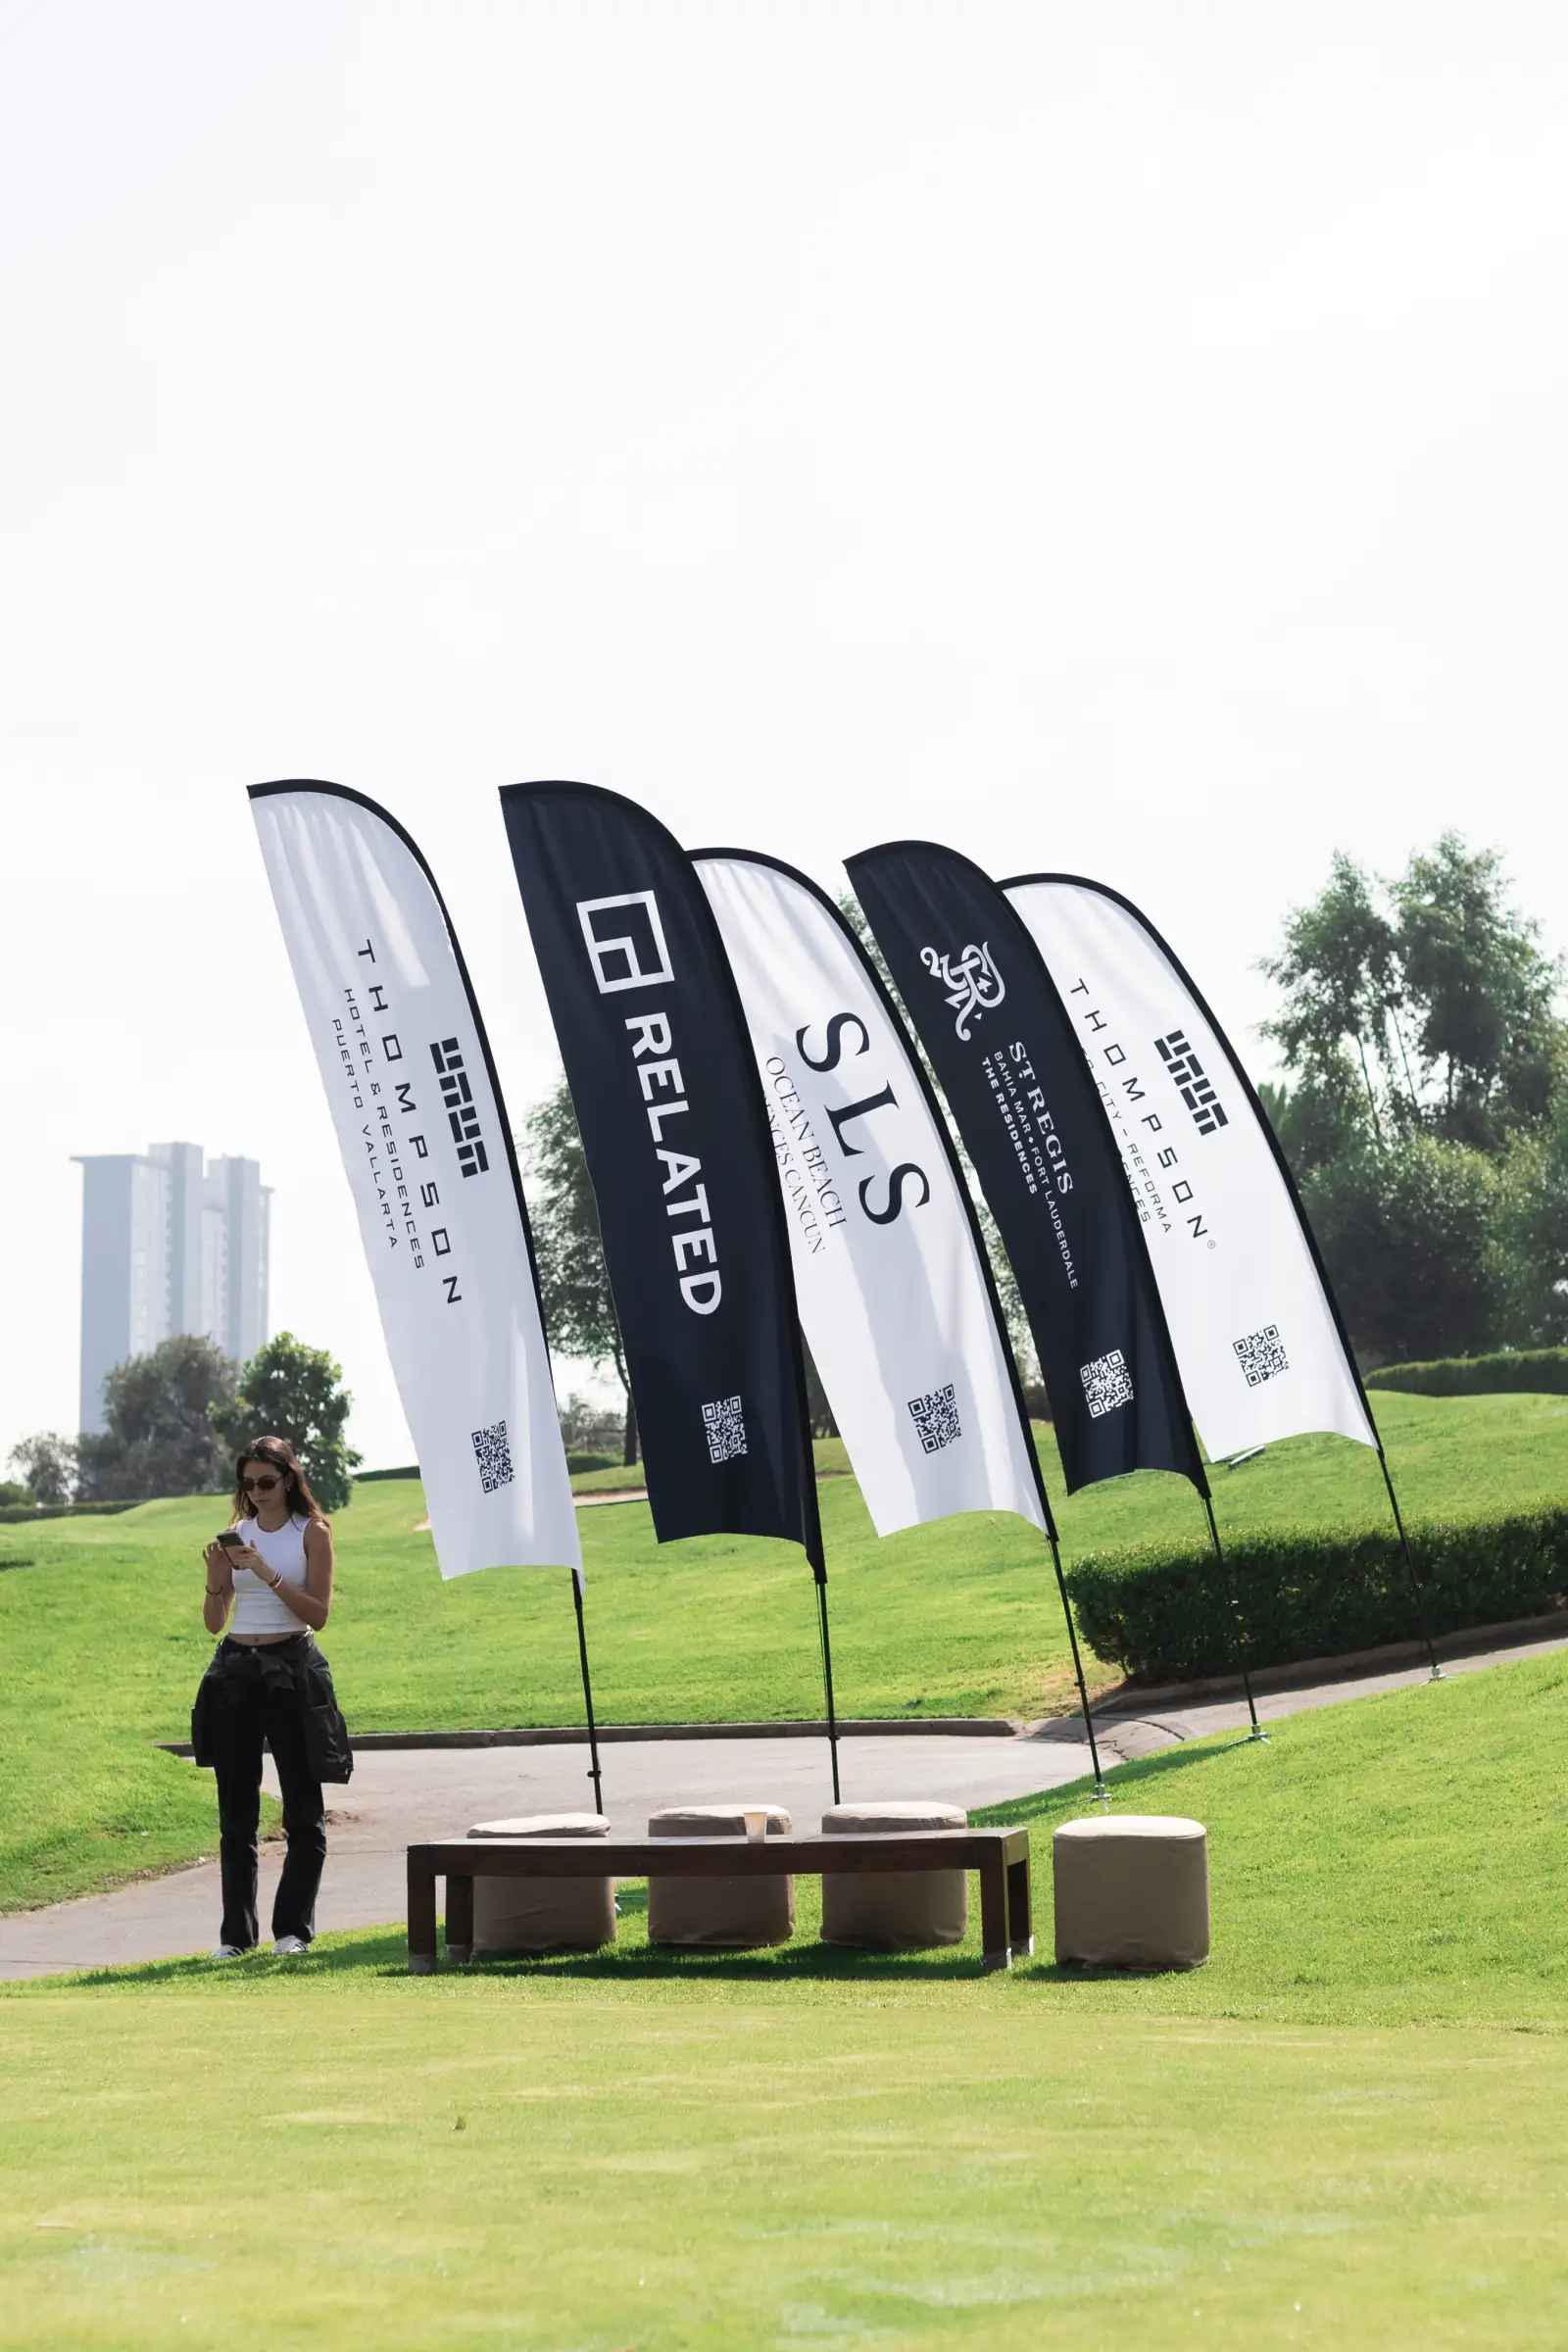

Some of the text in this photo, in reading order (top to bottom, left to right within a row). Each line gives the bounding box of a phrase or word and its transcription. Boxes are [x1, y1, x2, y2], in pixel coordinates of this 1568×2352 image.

[332, 1018, 397, 1249] PUERTO VALLARTA
[344, 988, 424, 1269] HOTEL & RESIDENCES
[358, 939, 462, 1303] THOMPSON
[625, 1011, 722, 1315] RELATED
[766, 1057, 847, 1227] OCEAN BEACH
[785, 1169, 825, 1253] CANCUN
[796, 1012, 930, 1225] SLS
[982, 1057, 1037, 1194] THE RESIDENCES
[994, 1051, 1078, 1289] BAHIA MAR FORT LAUDERDALE
[1027, 1086, 1073, 1194] REGIS
[1127, 1143, 1172, 1233] REFORMA
